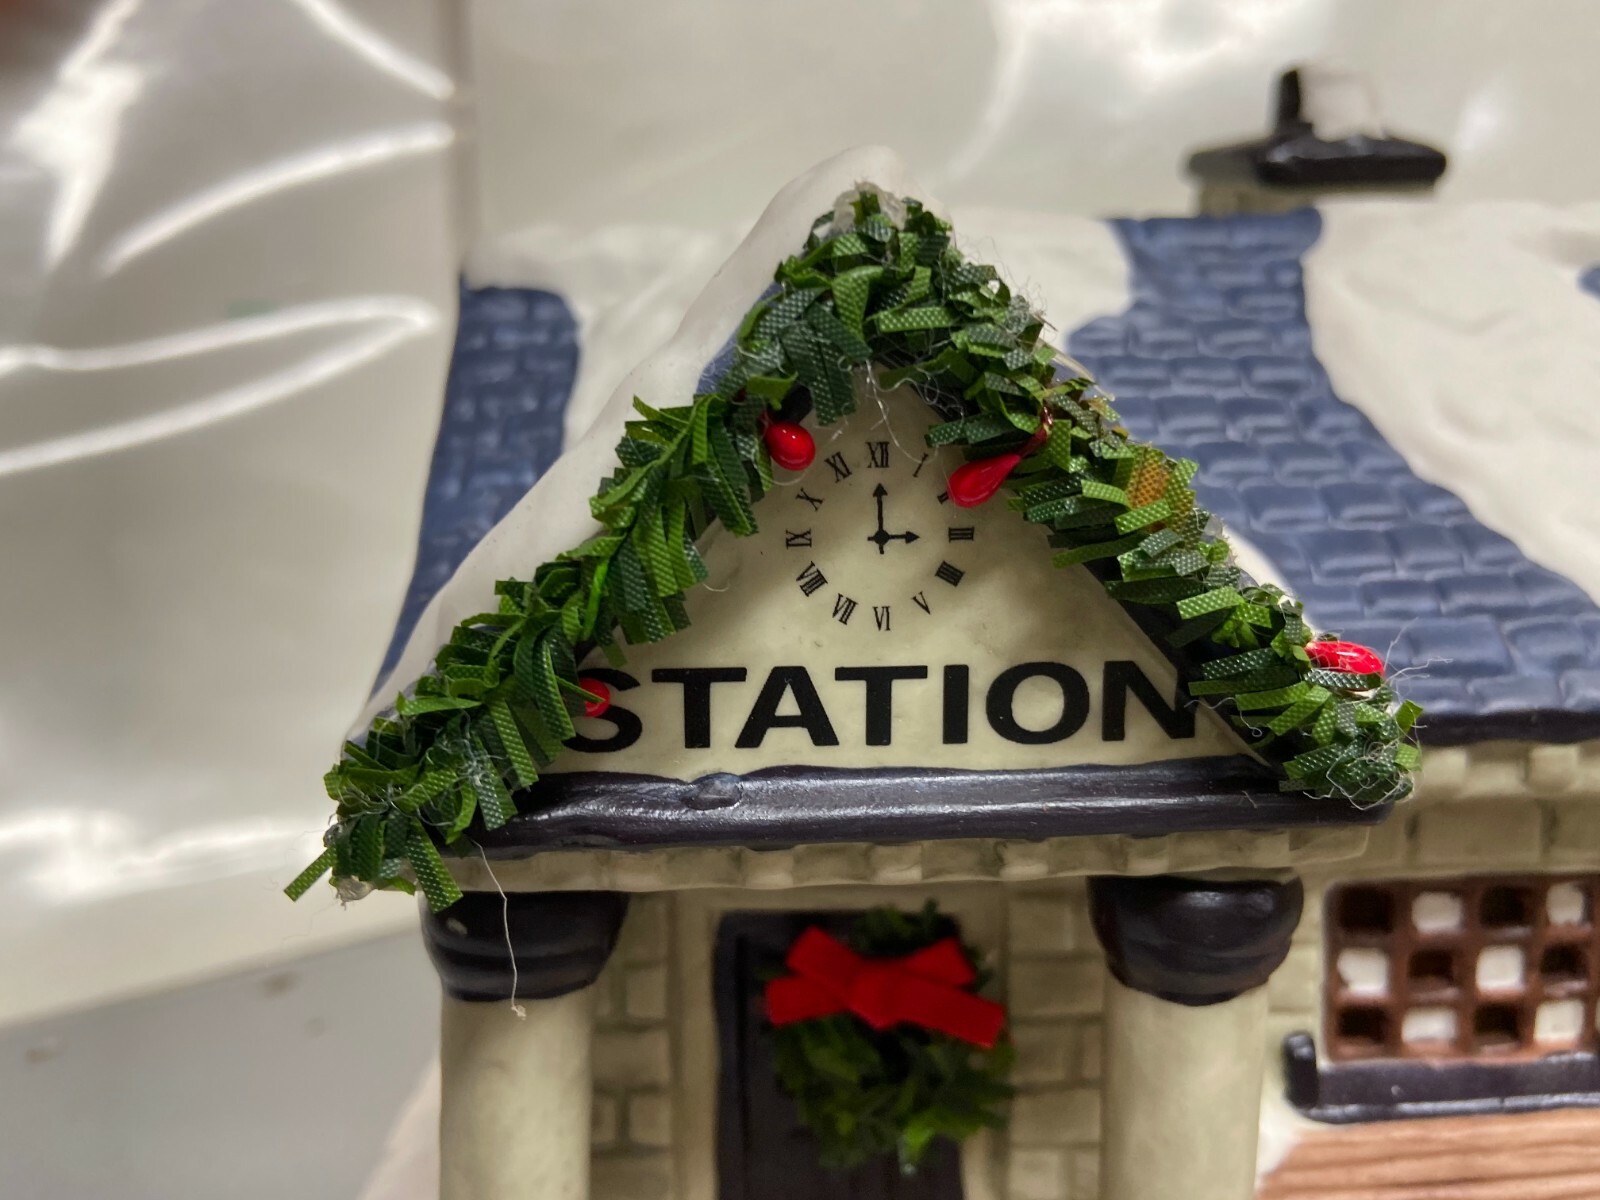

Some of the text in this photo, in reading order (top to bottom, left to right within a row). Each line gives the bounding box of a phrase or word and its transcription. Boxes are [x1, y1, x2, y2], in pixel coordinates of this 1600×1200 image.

[824, 451, 852, 483] XI
[865, 441, 890, 468] XII
[912, 452, 929, 478] I
[795, 488, 824, 511] X
[785, 528, 812, 550] IX
[948, 526, 975, 543] III
[796, 560, 828, 597] VIII
[832, 592, 859, 625] VII
[911, 591, 931, 615] V
[873, 606, 891, 631] VI
[560, 660, 1196, 753] STATION
